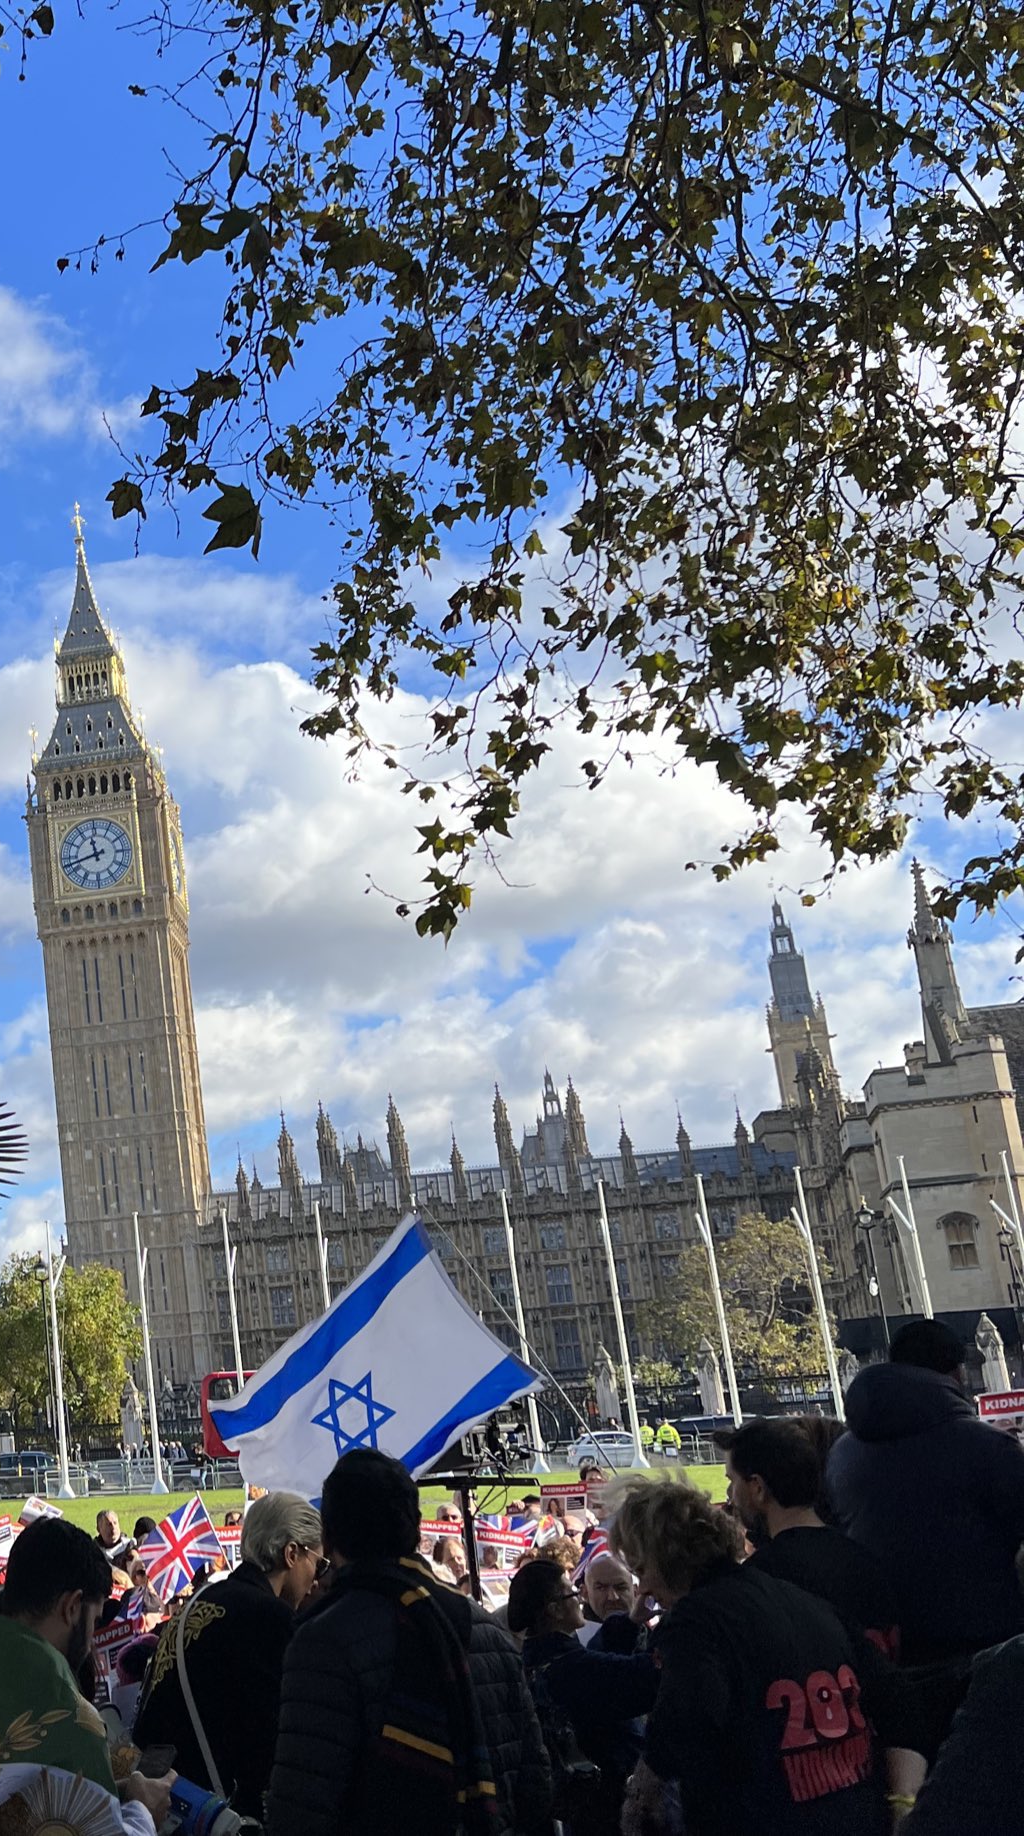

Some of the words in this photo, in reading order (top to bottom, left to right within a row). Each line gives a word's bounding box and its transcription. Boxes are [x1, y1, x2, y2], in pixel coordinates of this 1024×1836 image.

[985, 1396, 1024, 1411] KIDNA
[542, 1485, 586, 1494] KIDNAPPED
[420, 1521, 459, 1532] DNAPPED
[479, 1531, 523, 1544] KIDNAPPED
[94, 1626, 132, 1646] NAPPED
